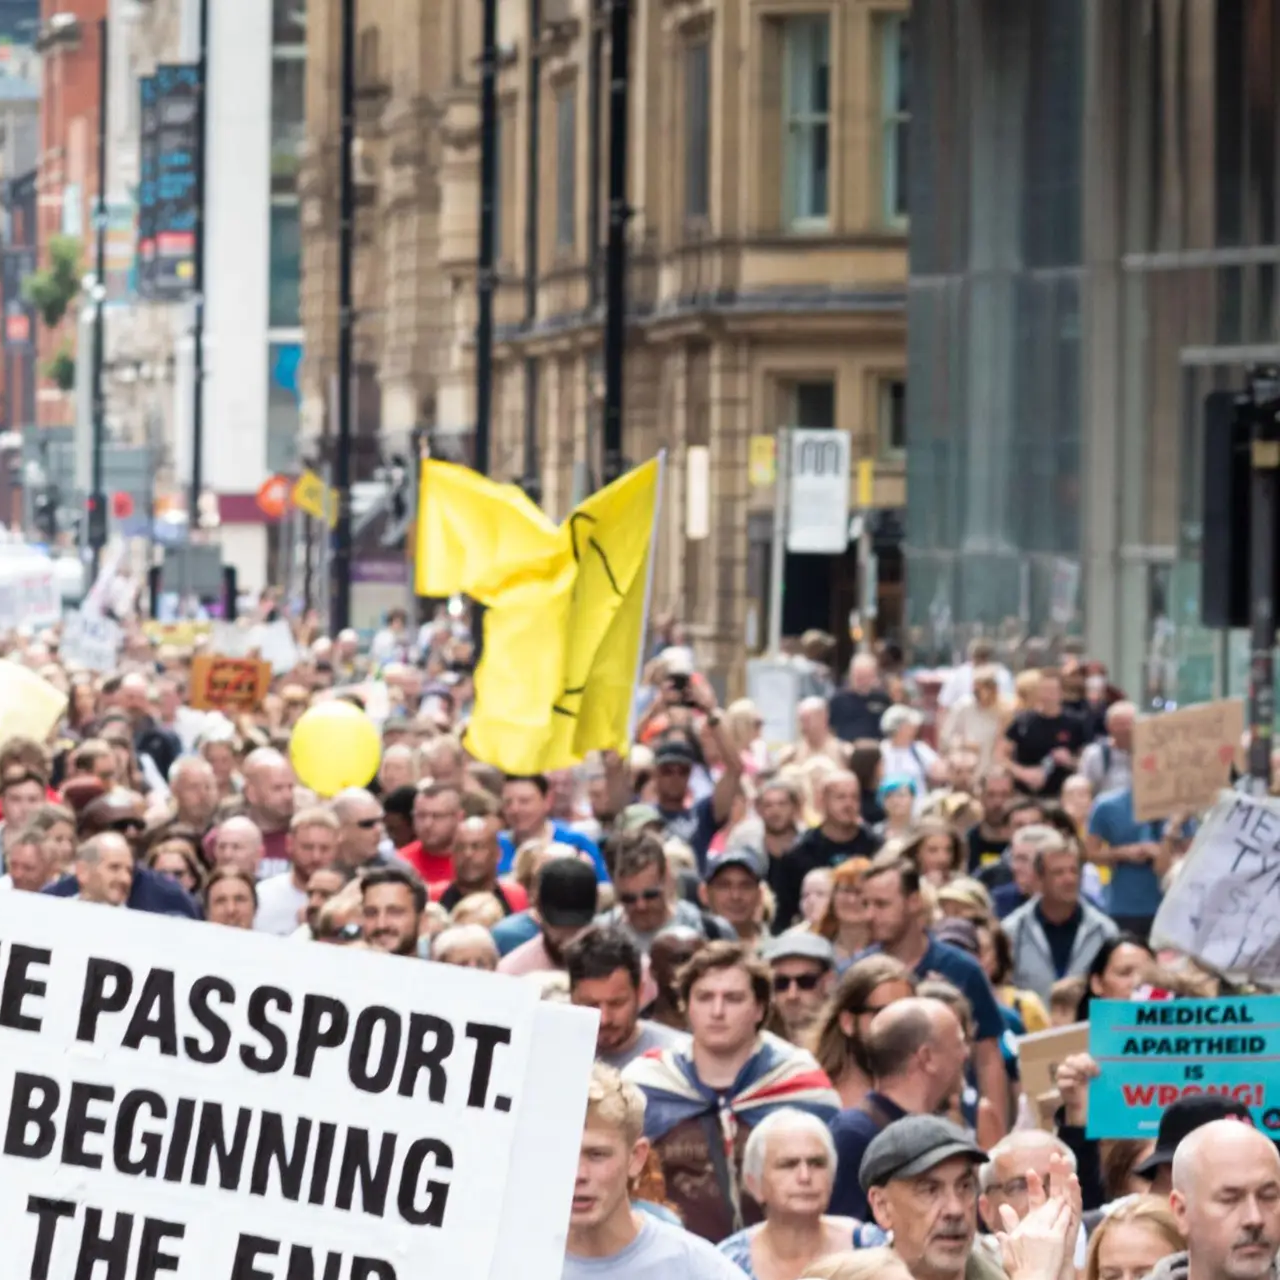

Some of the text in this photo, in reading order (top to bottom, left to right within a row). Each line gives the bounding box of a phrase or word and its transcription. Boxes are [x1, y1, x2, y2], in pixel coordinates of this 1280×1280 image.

[1136, 1004, 1254, 1026] MEDICAL
[76, 956, 512, 1112] PASSPORT.
[1122, 1035, 1266, 1055] APARTHEID
[1183, 1065, 1204, 1080] IS
[3, 1072, 453, 1227] BEGINNING
